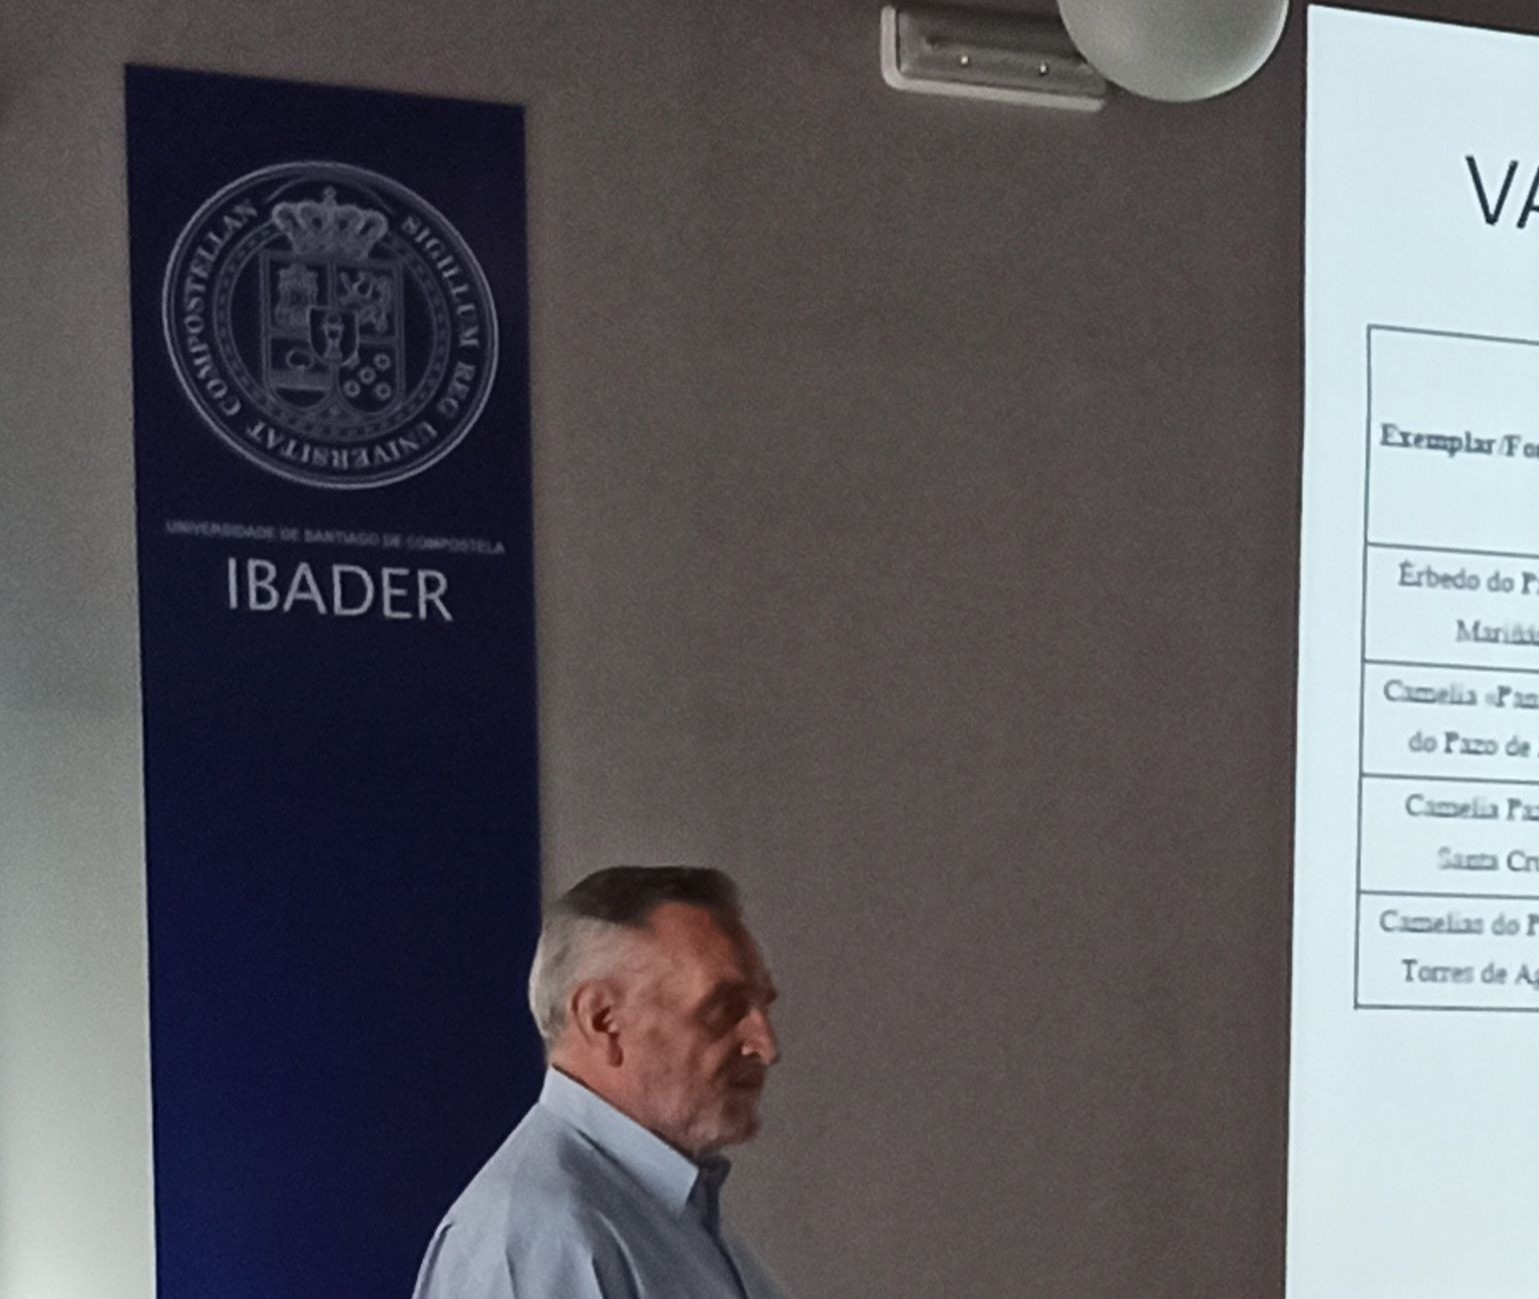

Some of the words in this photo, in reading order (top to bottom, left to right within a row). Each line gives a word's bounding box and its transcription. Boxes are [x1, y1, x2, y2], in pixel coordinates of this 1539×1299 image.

[228, 557, 454, 622] IBADER
[1487, 572, 1514, 592] do
[1408, 732, 1437, 752] do
[1444, 732, 1498, 755] Pazo
[1505, 736, 1530, 757] de
[1491, 914, 1520, 936] do
[1480, 962, 1508, 984] de
